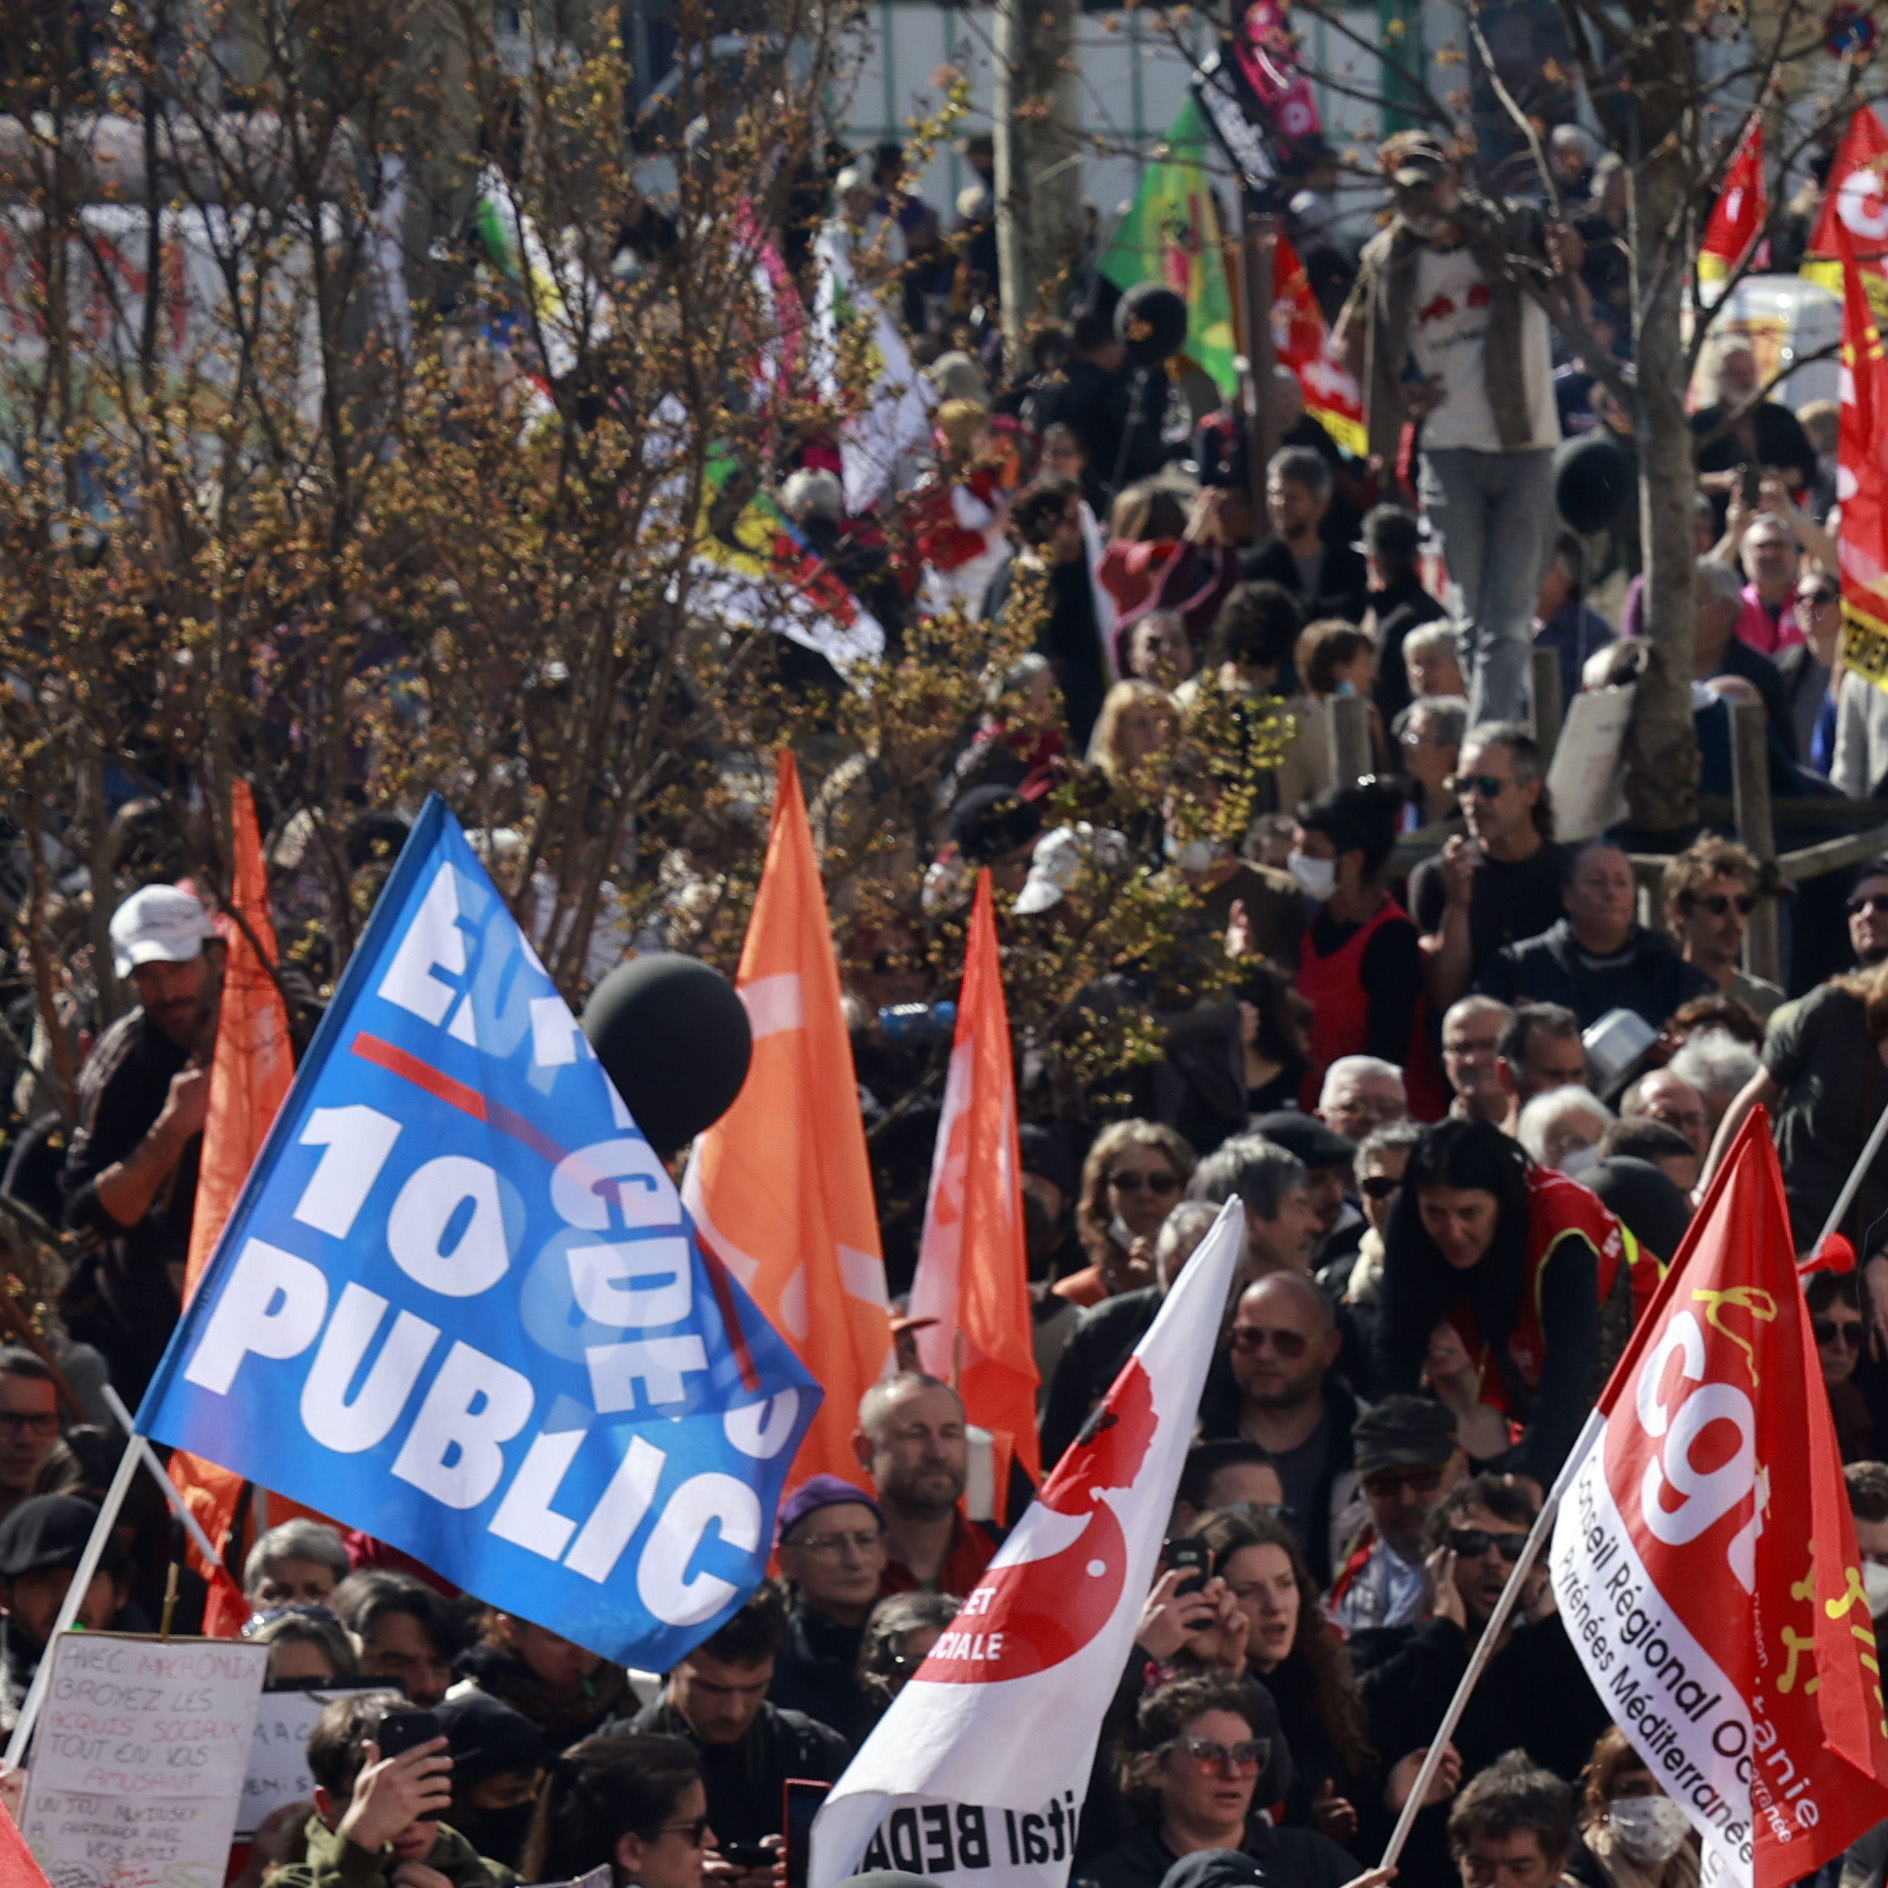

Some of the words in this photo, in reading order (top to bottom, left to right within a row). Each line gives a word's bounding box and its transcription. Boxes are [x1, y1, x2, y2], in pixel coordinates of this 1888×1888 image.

[182, 1236, 763, 1629] PUBLIC
[1578, 1455, 1620, 1573] Conseil
[1604, 1560, 1714, 1725] Régional
[60, 1645, 124, 1675] AVEC
[53, 1677, 164, 1712] BROYEZ
[170, 1687, 214, 1714] LES
[1557, 1543, 1616, 1674] Pyrénées
[1607, 1663, 1756, 1866] Méditerranée
[50, 1711, 135, 1738] ACQUIS
[150, 1720, 243, 1743] SOCIAUX
[50, 1732, 111, 1761] TOUT
[115, 1742, 149, 1764] EN
[83, 1766, 203, 1793] AMUSANT
